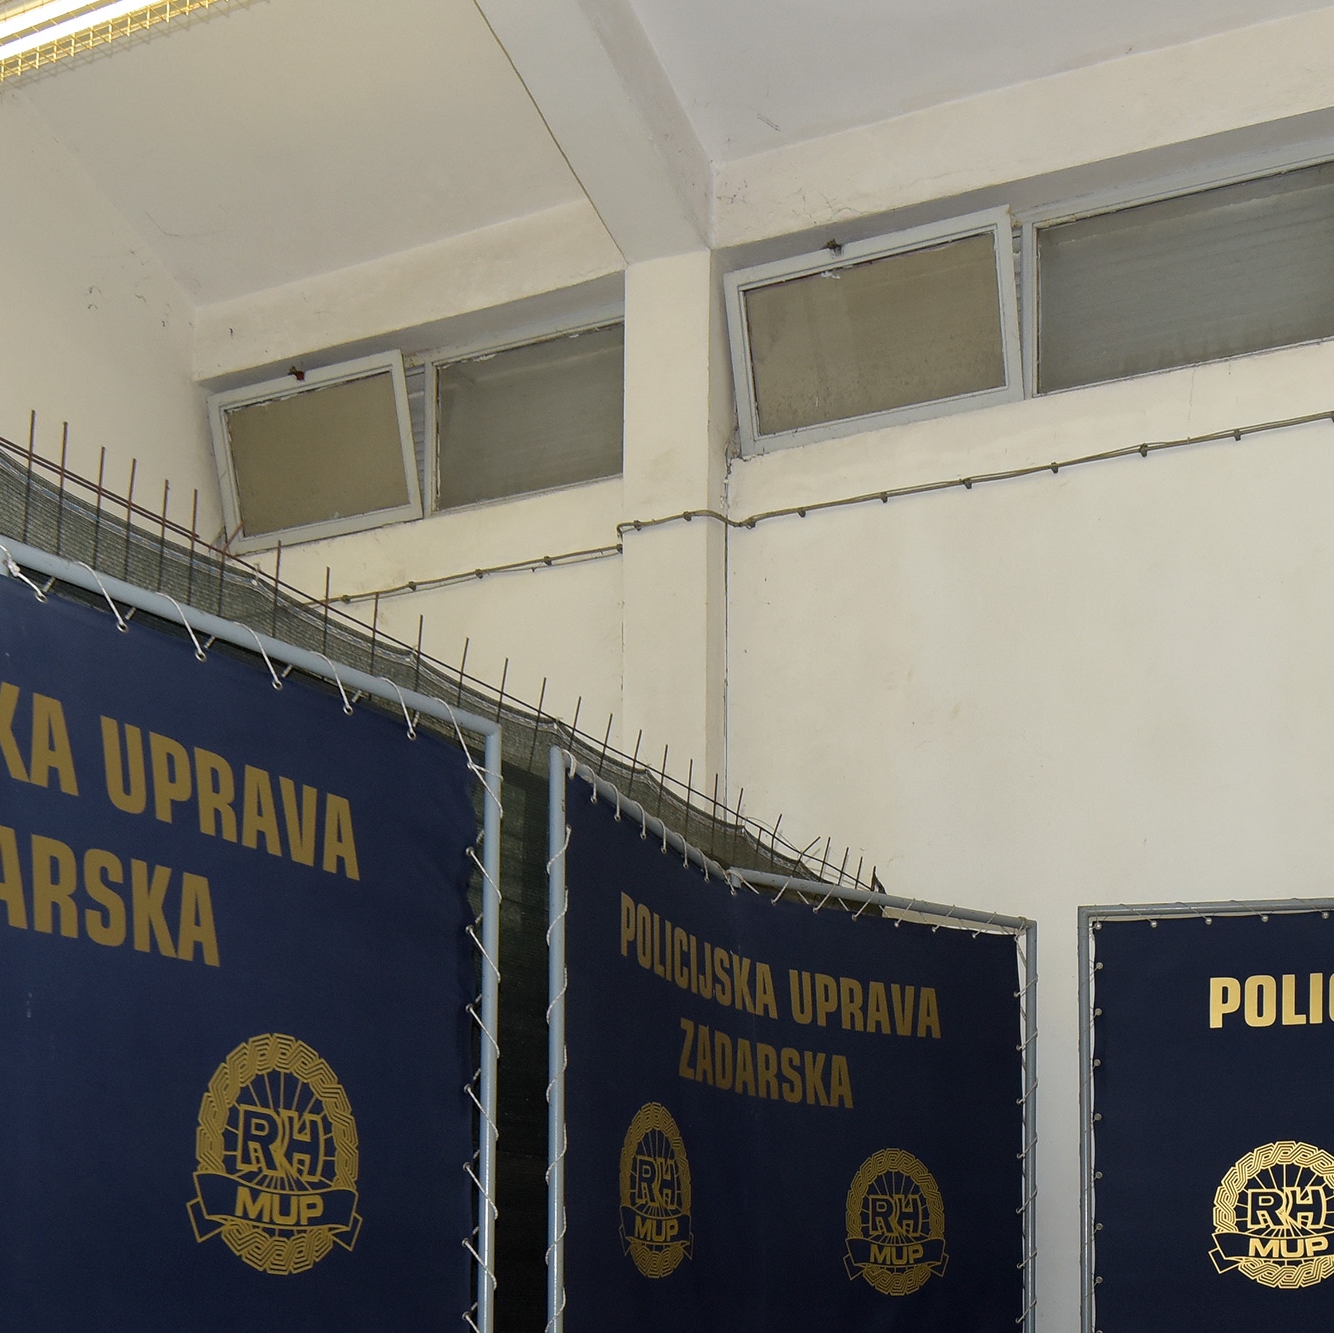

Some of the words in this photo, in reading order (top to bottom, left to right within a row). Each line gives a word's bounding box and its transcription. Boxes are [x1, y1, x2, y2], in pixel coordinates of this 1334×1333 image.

[101, 717, 359, 880] UPRAVA
[621, 893, 778, 1018] POLICIJSKA
[789, 970, 941, 1038] UPRAVA
[679, 1019, 853, 1108] ZADARSKA
[237, 1105, 324, 1184] RH
[635, 1156, 677, 1208] RH
[235, 1194, 324, 1226] MUP
[634, 1218, 679, 1242] MUP
[868, 1194, 922, 1238] RH
[1247, 1186, 1327, 1230] RH
[870, 1245, 924, 1265] MUP
[1248, 1235, 1329, 1259] MUP
